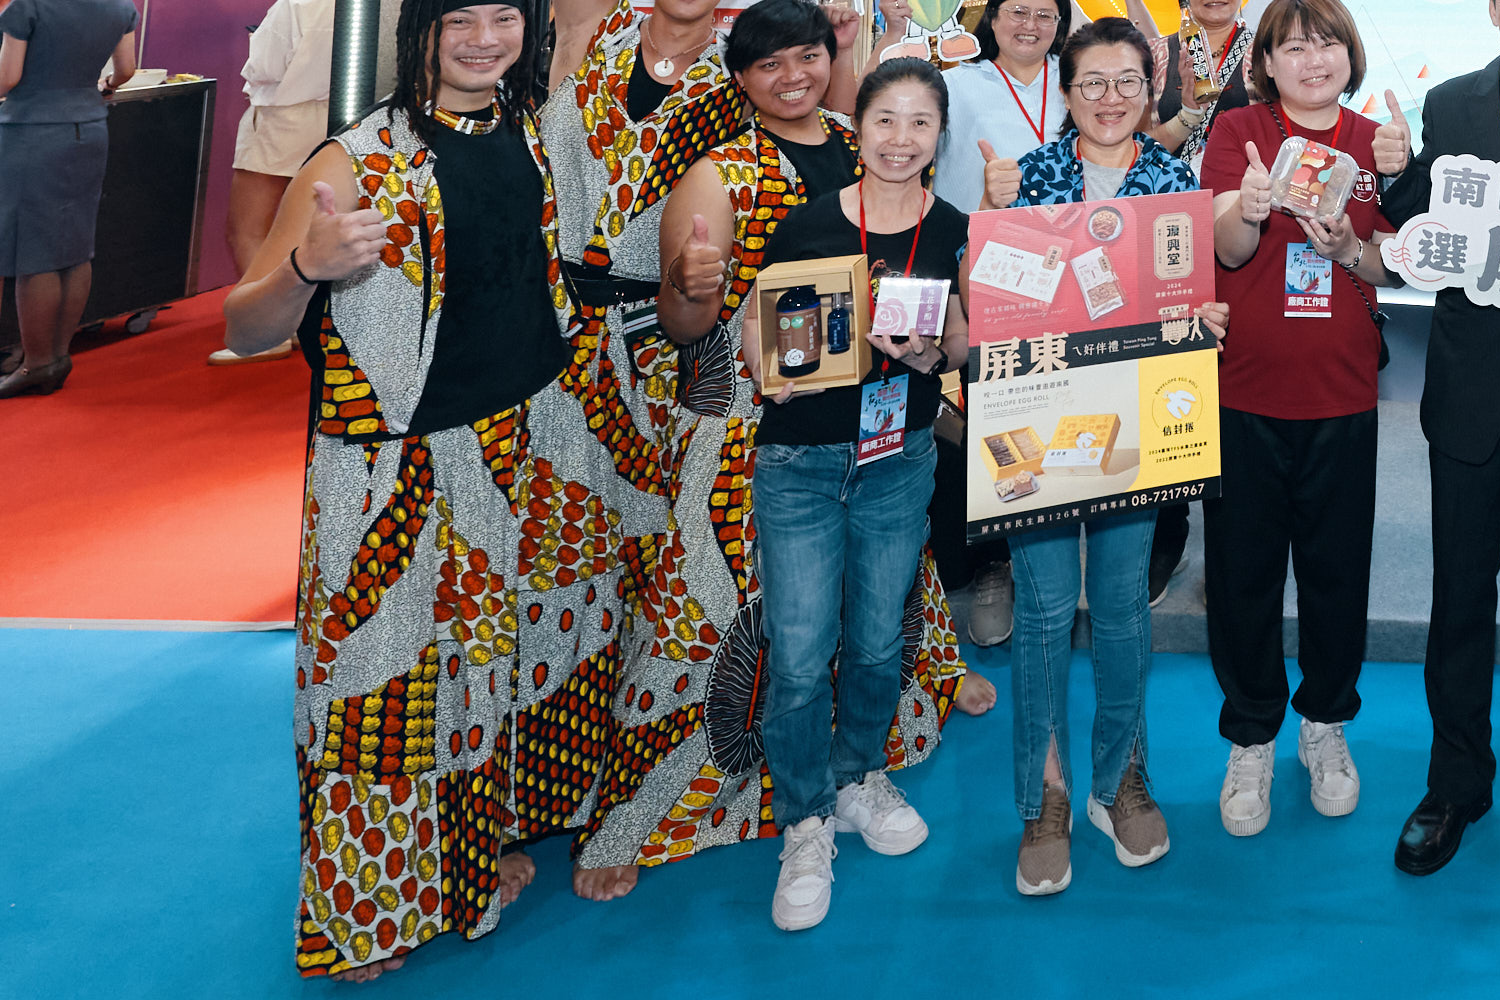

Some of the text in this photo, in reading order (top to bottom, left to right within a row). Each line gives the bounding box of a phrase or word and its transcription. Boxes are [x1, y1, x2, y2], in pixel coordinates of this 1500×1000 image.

[977, 331, 1070, 386] 屏東
[1162, 421, 1194, 437] 信封捲
[981, 508, 1080, 535] 屏東市民生路126號
[1131, 482, 1205, 508] 08-7217967
